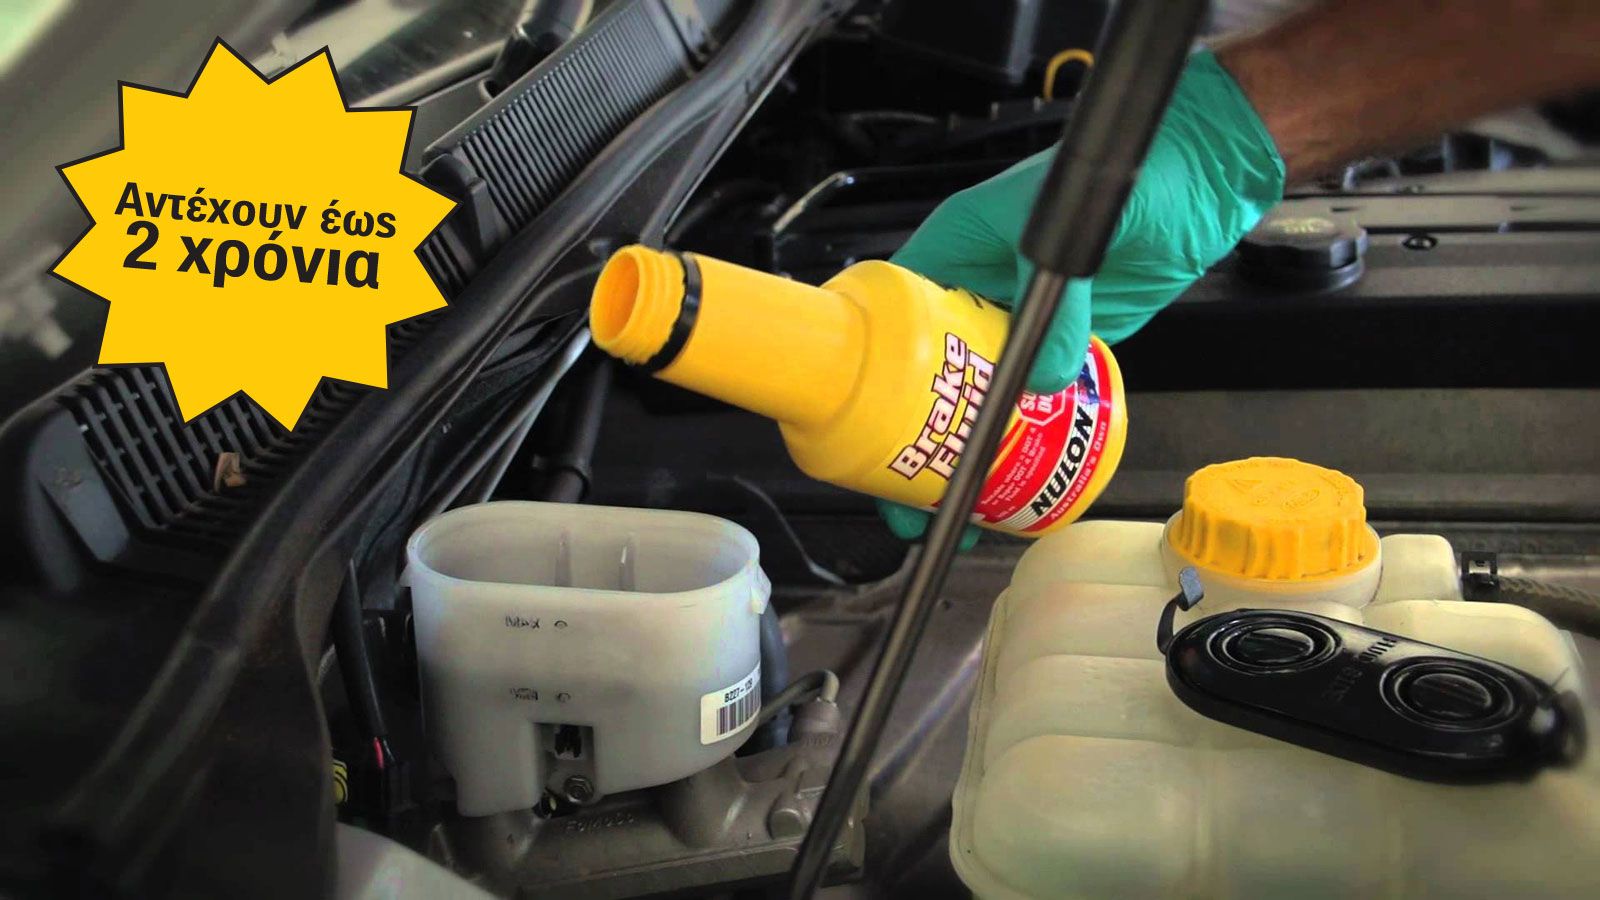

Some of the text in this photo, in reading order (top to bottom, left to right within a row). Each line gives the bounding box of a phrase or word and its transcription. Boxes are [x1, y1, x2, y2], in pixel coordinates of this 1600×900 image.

[887, 332, 967, 481] Brake
[1022, 435, 1034, 454] DOT
[1013, 466, 1028, 481] DOT
[1030, 405, 1094, 517] NULON
[1050, 420, 1107, 520] Australia's Own
